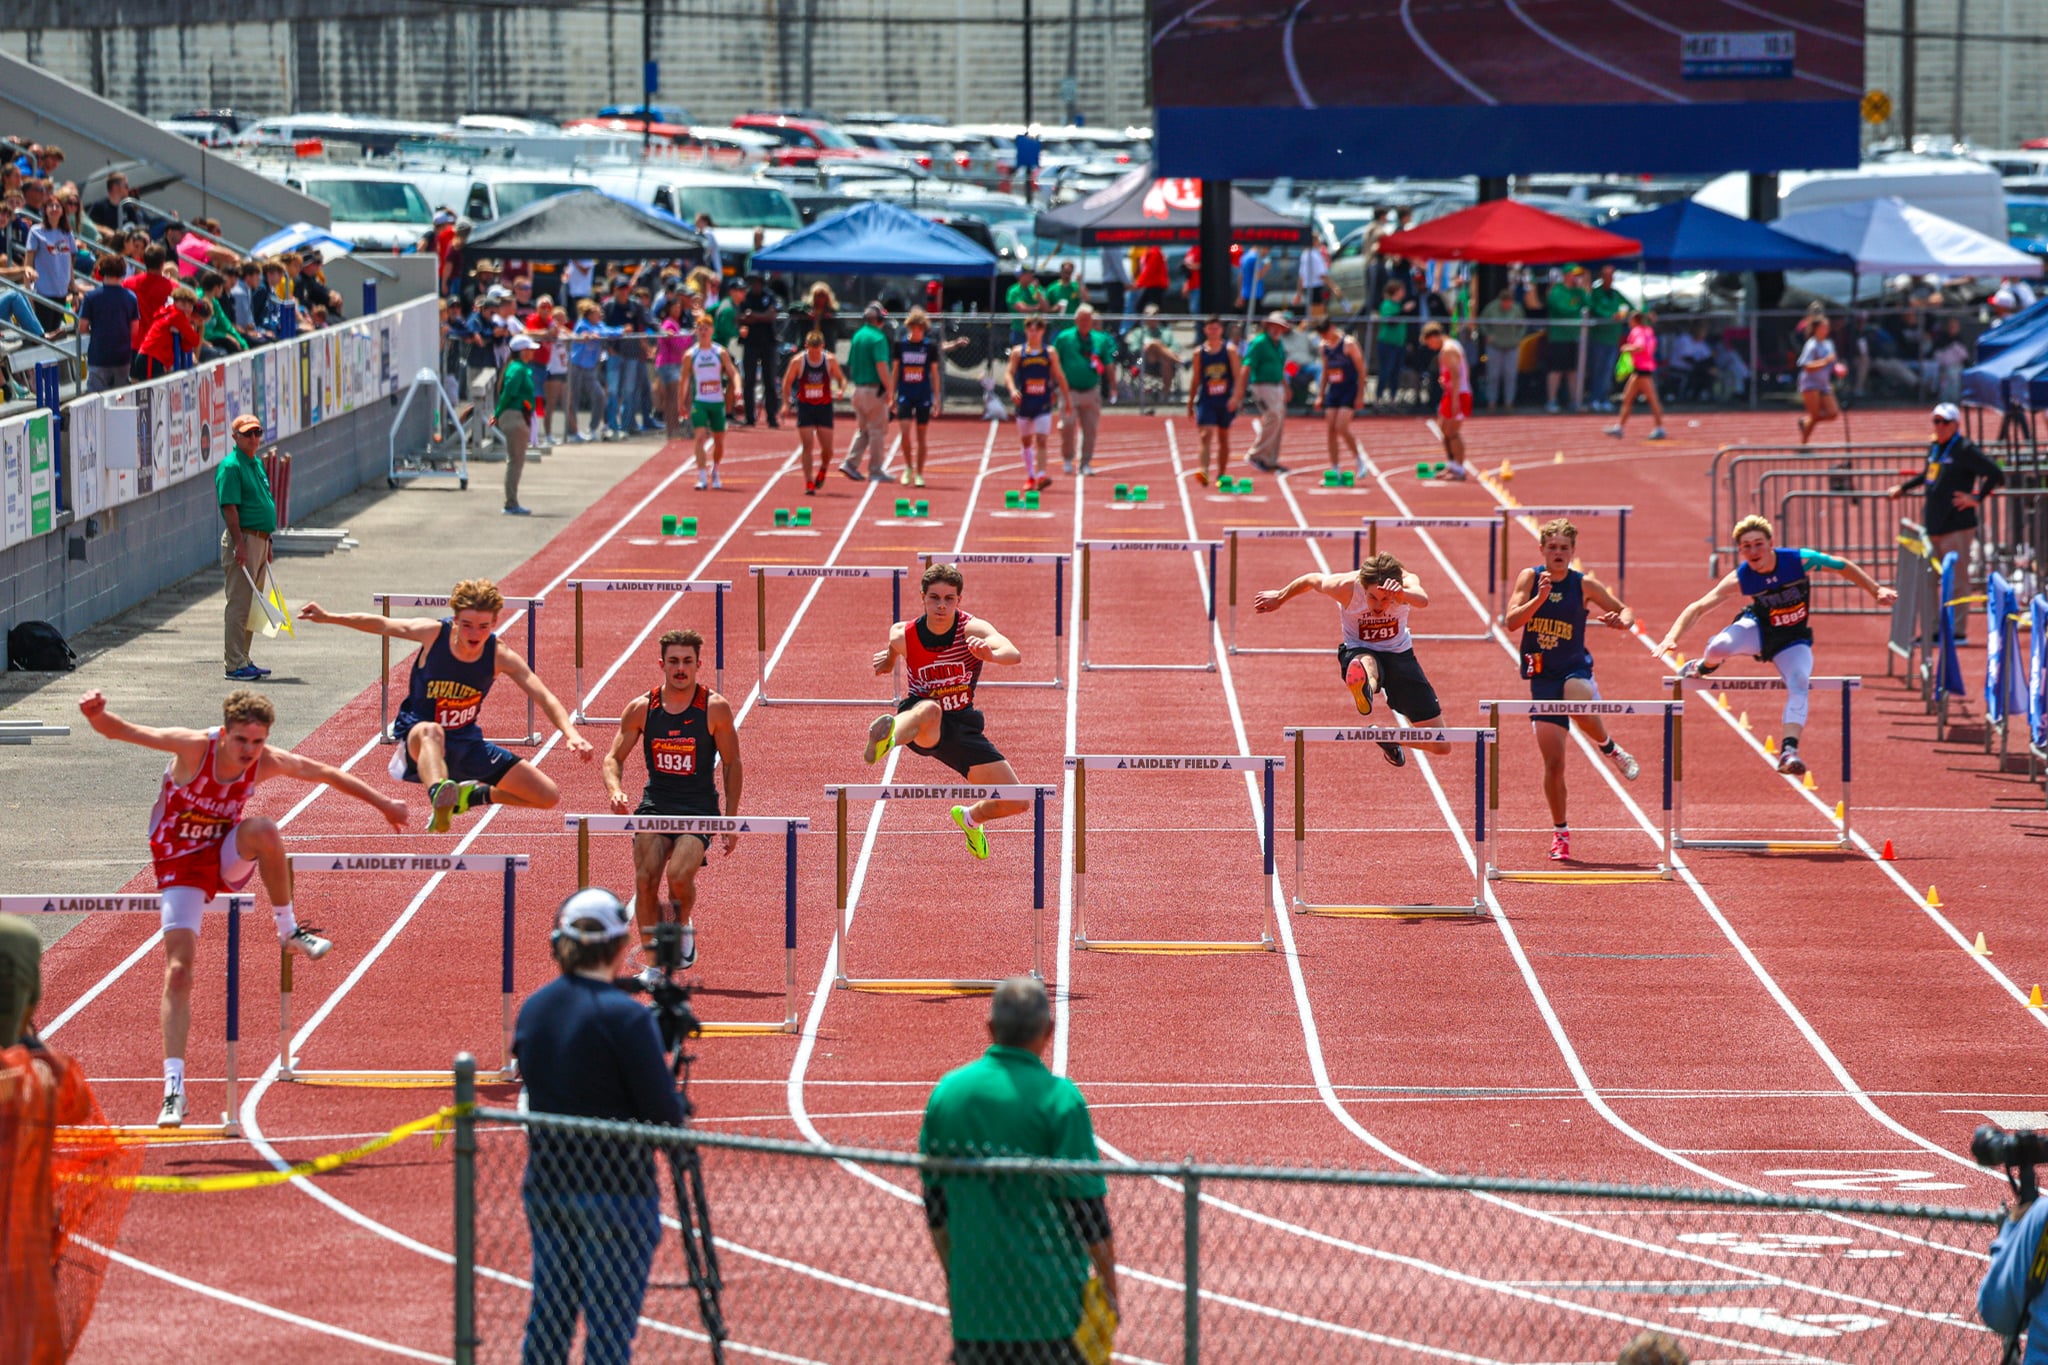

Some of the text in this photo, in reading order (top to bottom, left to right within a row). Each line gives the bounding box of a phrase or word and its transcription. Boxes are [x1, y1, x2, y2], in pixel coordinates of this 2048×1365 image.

[963, 555, 1025, 563] LAIDLEY FIELD
[797, 568, 861, 576] LAIDLEY FIELD
[616, 582, 682, 591] LAIDLEY FIELD
[424, 597, 448, 606] LAID
[1363, 626, 1396, 640] 1791
[1527, 617, 1573, 641] CAVALIERS
[920, 662, 964, 682] UNION
[1771, 681, 1788, 690] FIE
[1540, 703, 1623, 714] LAIDLEY FIELD
[438, 705, 477, 727] 1209
[1347, 731, 1433, 741] LAIDLEY FIELD
[656, 752, 692, 771] 1934
[1130, 758, 1219, 769] LAIDLEY FIELD
[894, 788, 987, 799] LAIDLEY FIELD
[638, 819, 736, 831] LAIDLEY FIELD
[347, 858, 451, 870] LAIDLEY FIELD
[59, 898, 161, 911] LAIDLEY FIEL
